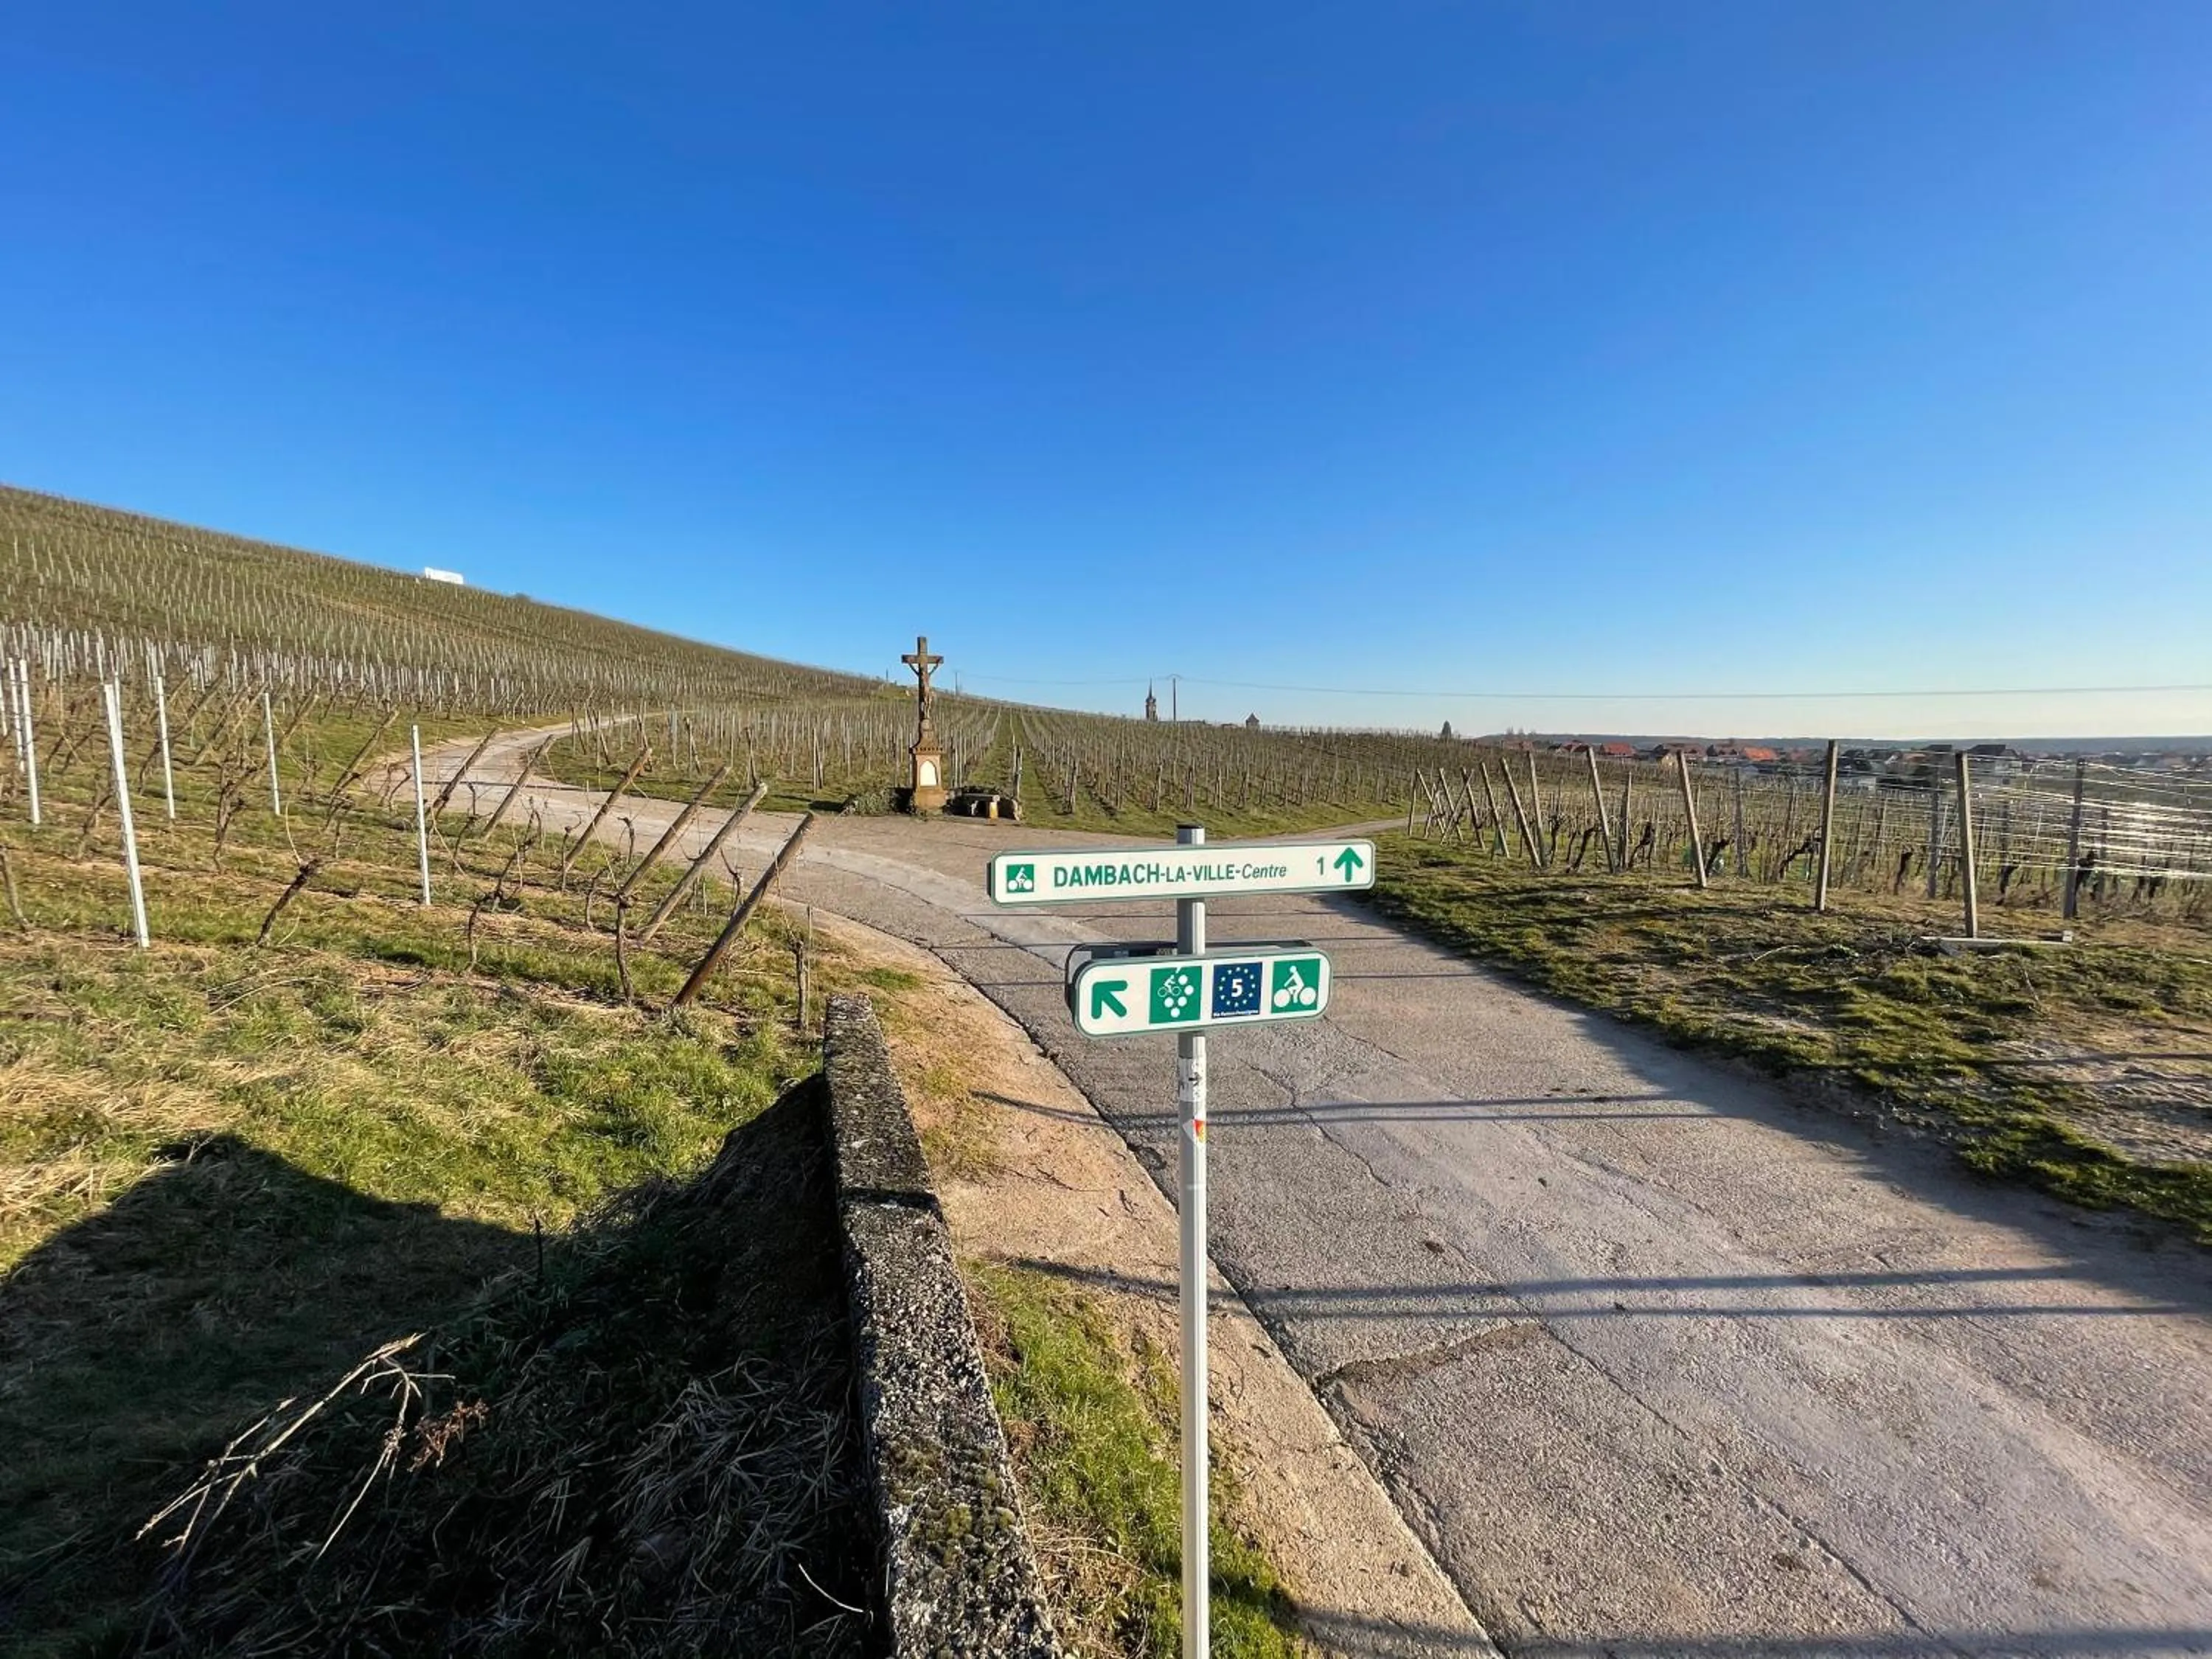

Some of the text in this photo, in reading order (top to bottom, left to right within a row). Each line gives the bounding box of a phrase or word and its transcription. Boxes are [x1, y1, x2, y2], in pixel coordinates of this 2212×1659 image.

[1054, 856, 1325, 888] DAMBACH-LA-VILLE-Centre 1
[1231, 978, 1243, 998] 5
